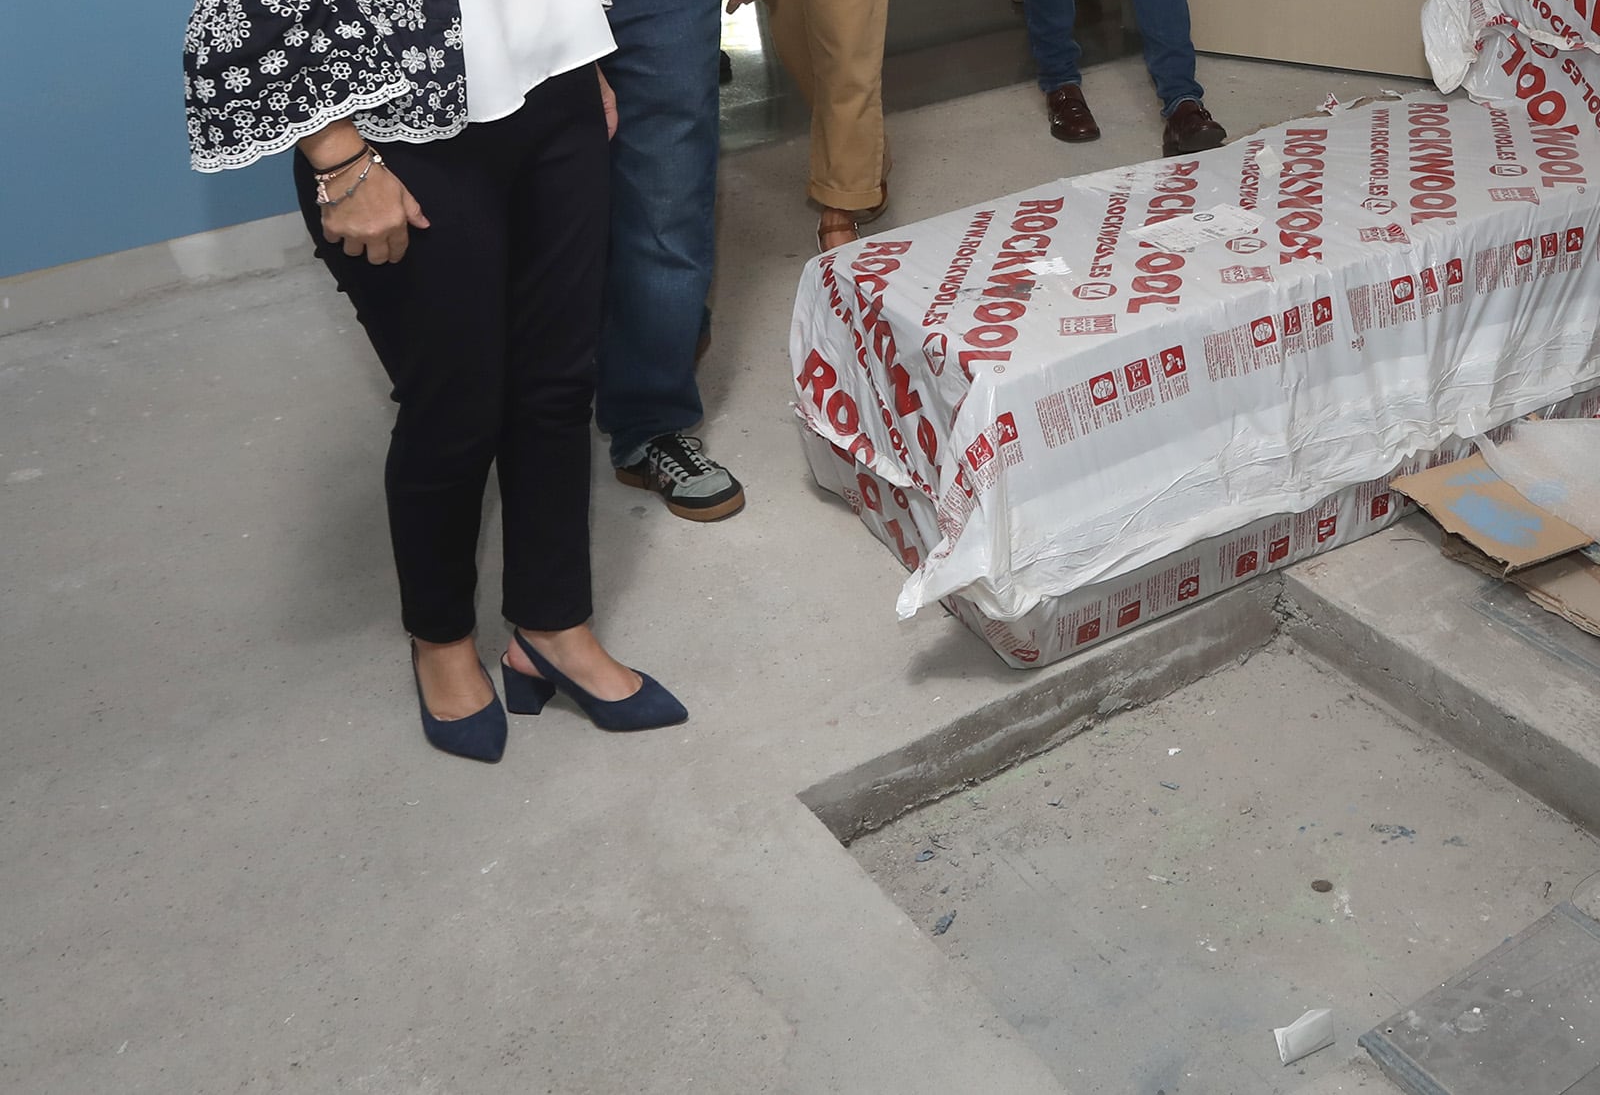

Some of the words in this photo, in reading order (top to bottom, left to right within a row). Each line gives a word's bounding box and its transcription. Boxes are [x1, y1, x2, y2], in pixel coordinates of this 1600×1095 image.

[1408, 101, 1458, 225] ROCKWOOL
[921, 210, 997, 327] WWW.ROCKWOOL.ES
[958, 196, 1065, 383] ROCKWOOL
[1126, 160, 1200, 314] ROCKOOL
